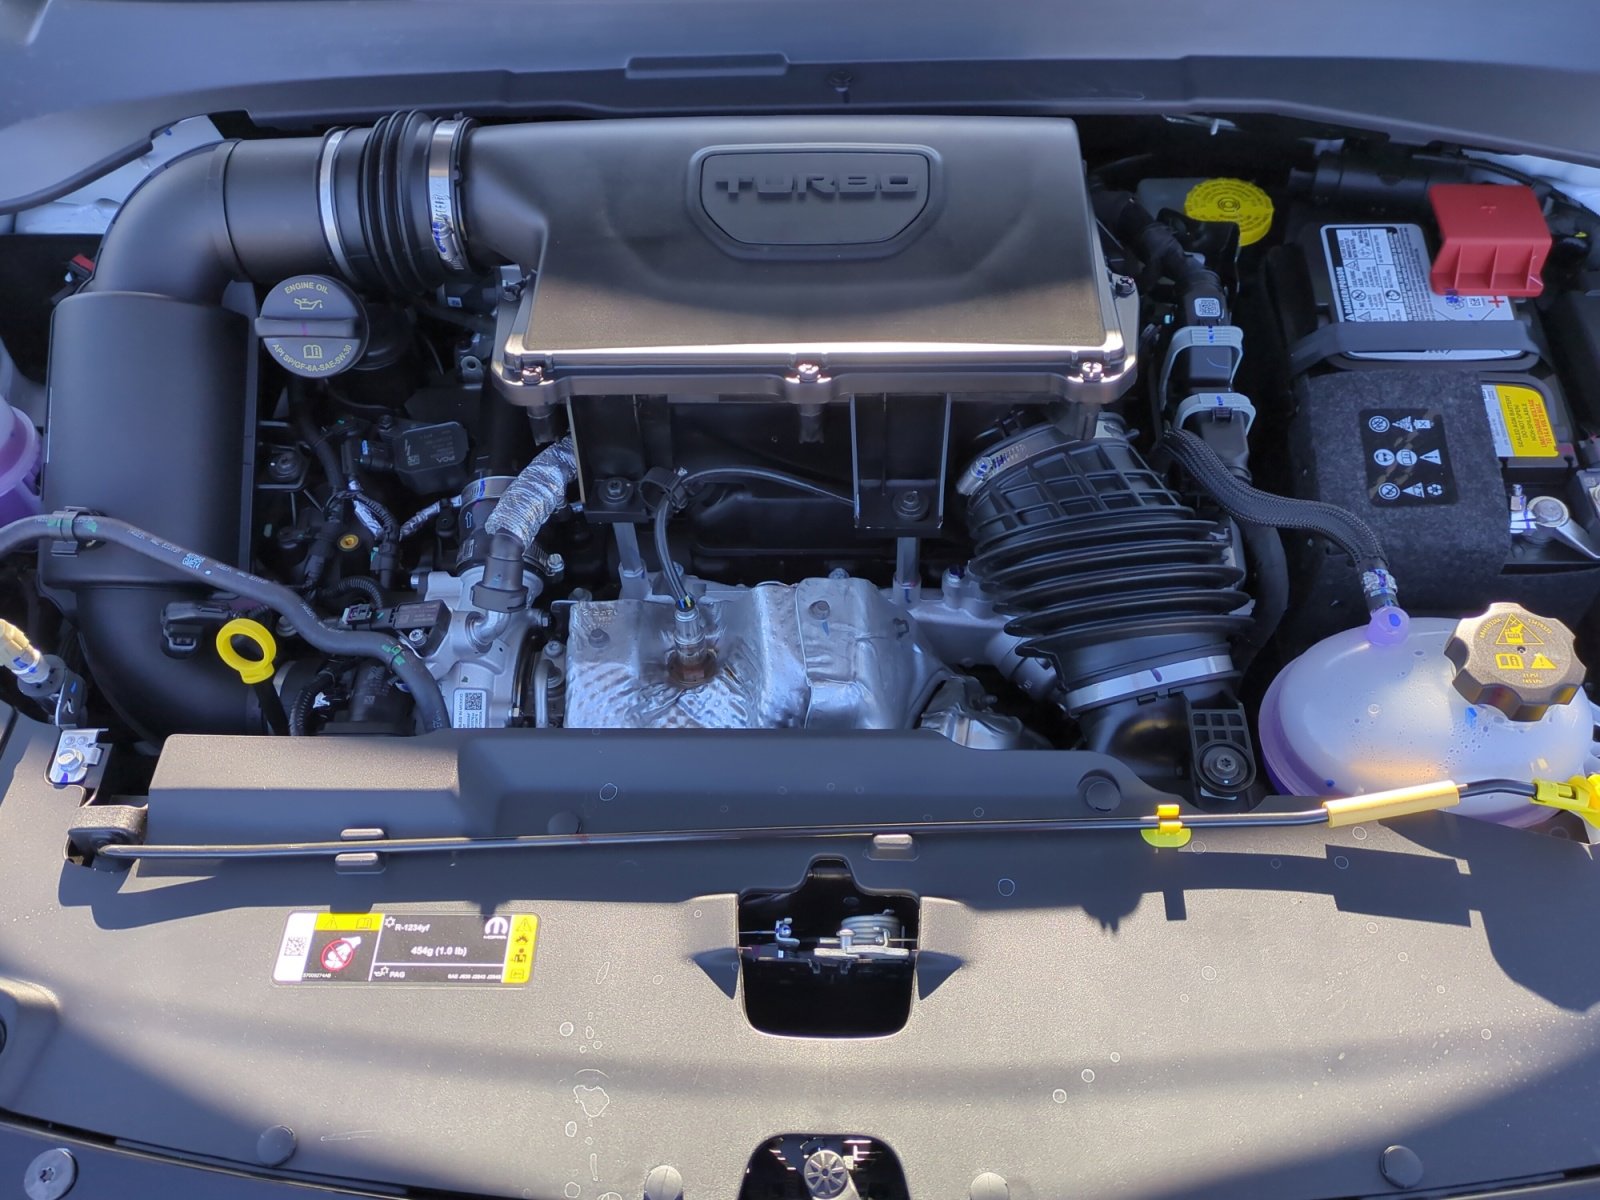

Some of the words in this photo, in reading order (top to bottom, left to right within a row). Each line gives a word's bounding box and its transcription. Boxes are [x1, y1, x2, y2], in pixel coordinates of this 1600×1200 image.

[715, 174, 918, 201] TURBO
[284, 282, 314, 294] ENGINE
[315, 285, 329, 294] OIL
[1336, 267, 1353, 313] DANGER/POISON
[272, 344, 283, 356] API
[1504, 395, 1515, 417] BATTERY
[1513, 428, 1524, 448] SEALED
[395, 924, 431, 933] R-1234yf
[410, 946, 434, 957] 454g
[435, 946, 453, 957] (1.0
[454, 946, 467, 957] lb)
